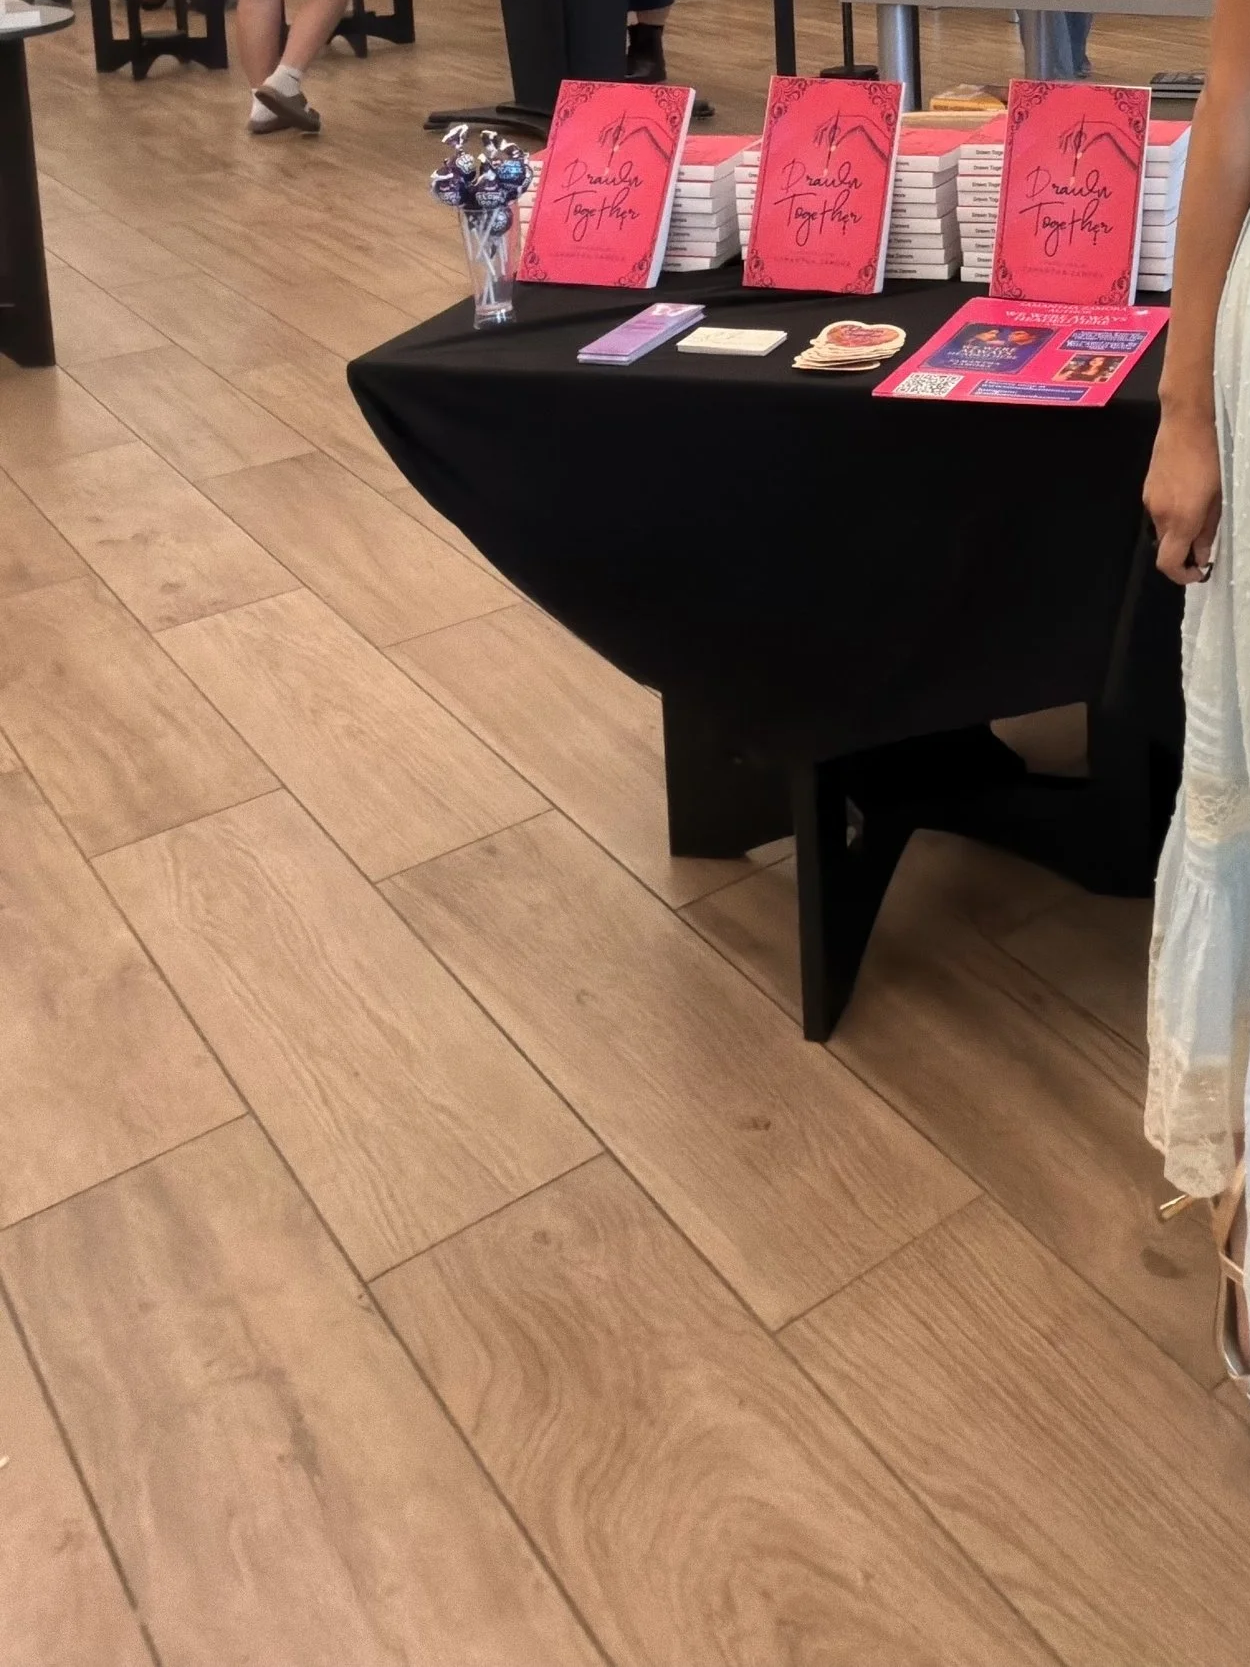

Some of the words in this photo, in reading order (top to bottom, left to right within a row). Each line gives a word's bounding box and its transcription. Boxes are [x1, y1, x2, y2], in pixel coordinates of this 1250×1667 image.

[553, 186, 640, 242] Together
[774, 189, 862, 247] Together
[1019, 198, 1114, 258] Together
